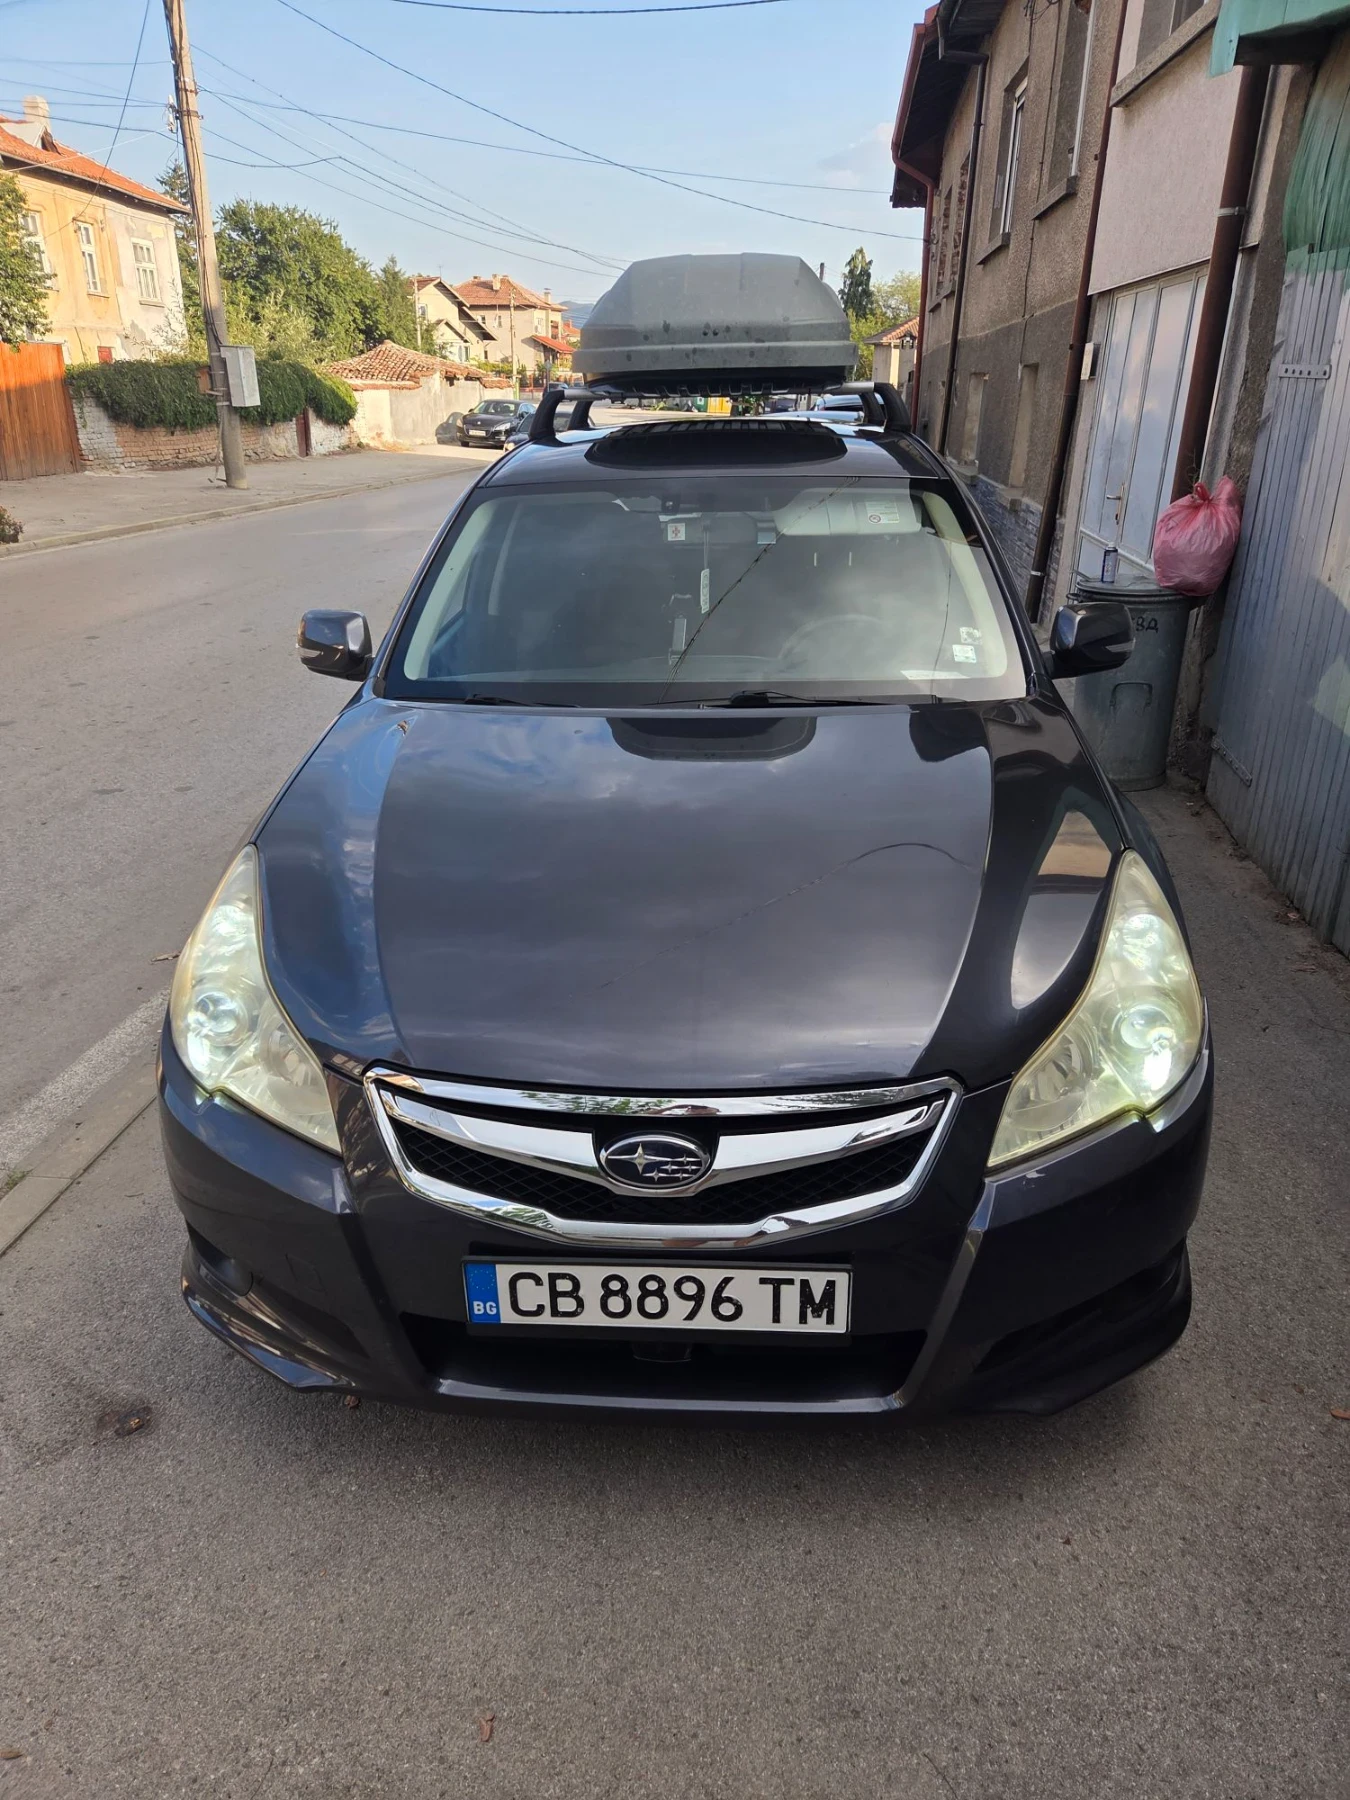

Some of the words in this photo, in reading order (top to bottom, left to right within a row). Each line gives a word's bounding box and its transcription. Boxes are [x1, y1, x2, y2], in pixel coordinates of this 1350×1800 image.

[473, 1301, 497, 1315] BG
[508, 1271, 585, 1318] CB
[600, 1273, 744, 1323] 8896
[758, 1276, 837, 1326] TM
